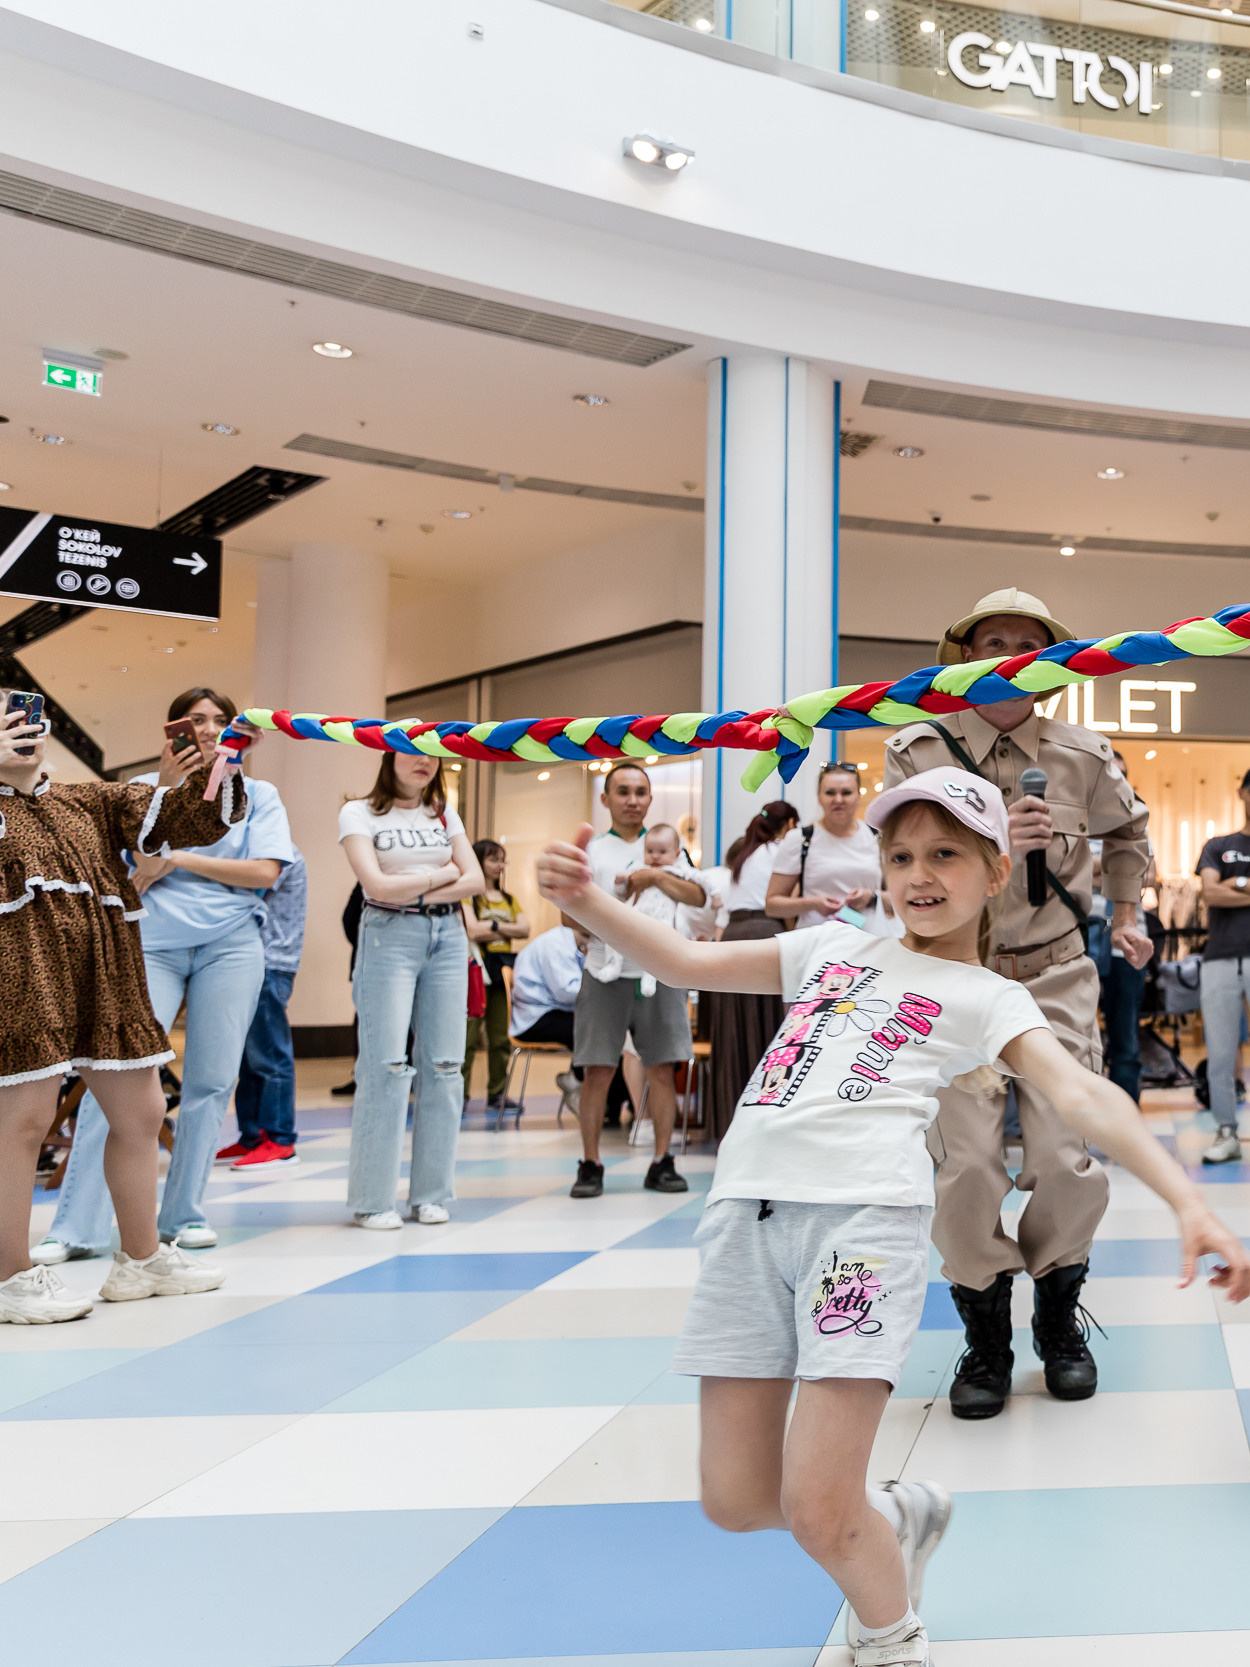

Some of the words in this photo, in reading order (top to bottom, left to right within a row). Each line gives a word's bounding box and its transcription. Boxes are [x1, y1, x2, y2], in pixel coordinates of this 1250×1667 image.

[58, 538, 122, 558] SOKOLOV
[58, 550, 108, 568] TEZENIS
[838, 992, 942, 1102] Minnie
[836, 1274, 853, 1286] so
[877, 1646, 912, 1660] sports
